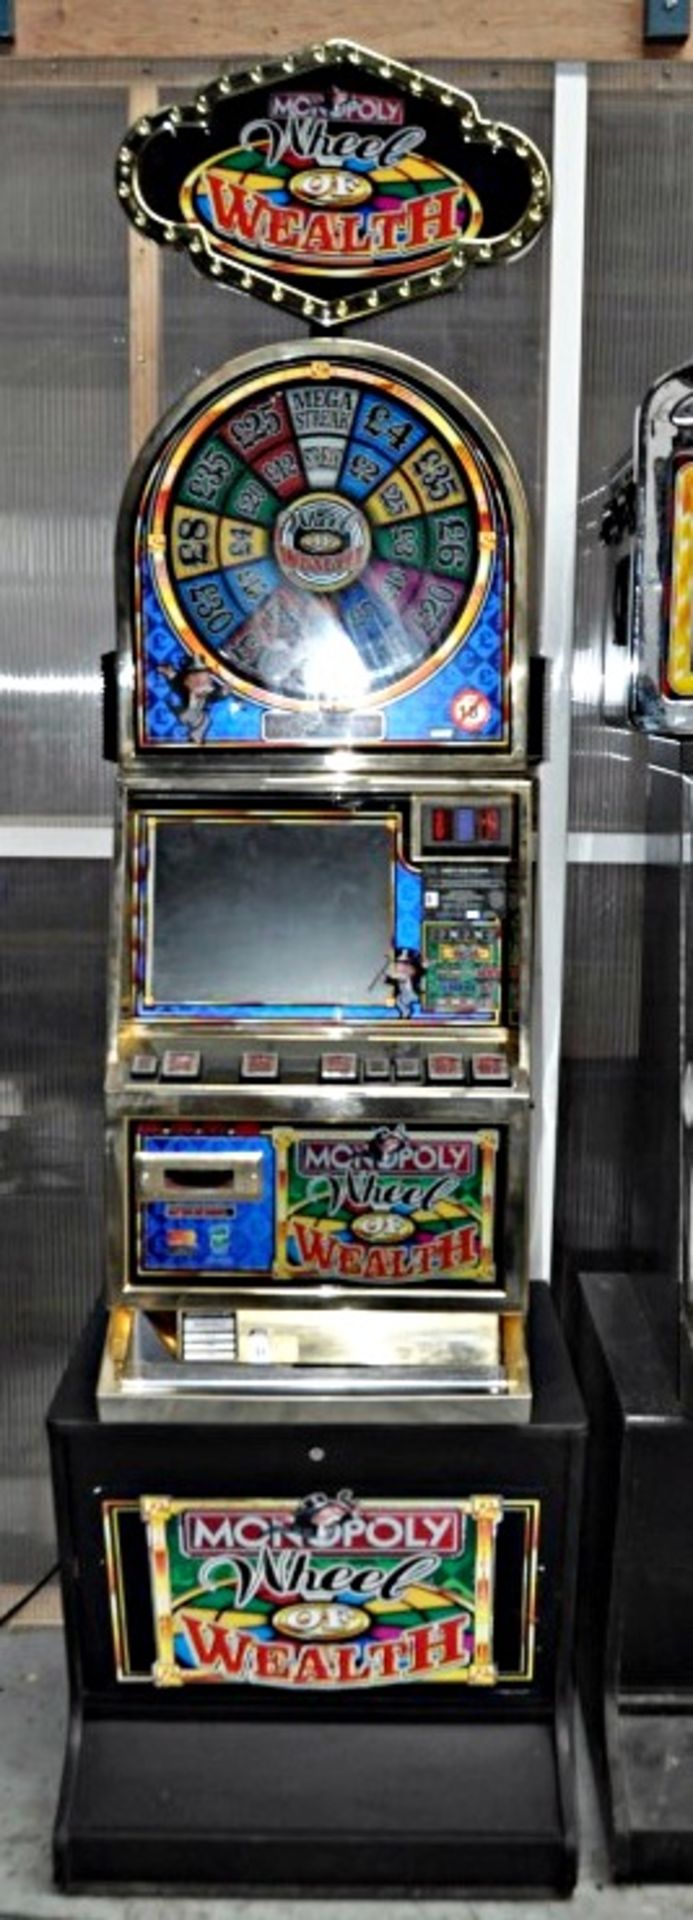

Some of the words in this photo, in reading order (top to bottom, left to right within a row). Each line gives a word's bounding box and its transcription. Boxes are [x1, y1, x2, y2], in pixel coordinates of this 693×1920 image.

[239, 117, 426, 168] Wheel
[301, 171, 361, 198] OF
[205, 173, 463, 254] WEALTH
[292, 388, 352, 411] MEGA
[229, 402, 282, 449] £25
[364, 404, 414, 450] £4
[187, 446, 233, 502] £35
[412, 448, 458, 502] £35
[177, 518, 209, 567] £8
[437, 516, 469, 569] £6
[189, 583, 234, 634] £30
[306, 1172, 459, 1216] Wheel
[360, 1214, 402, 1233] OF
[293, 1223, 478, 1278] WEALTH
[195, 1516, 451, 1548] MONOPOLY
[201, 1548, 441, 1608] Wheel
[288, 1605, 351, 1629] OF
[182, 1616, 468, 1682] WEALTH
